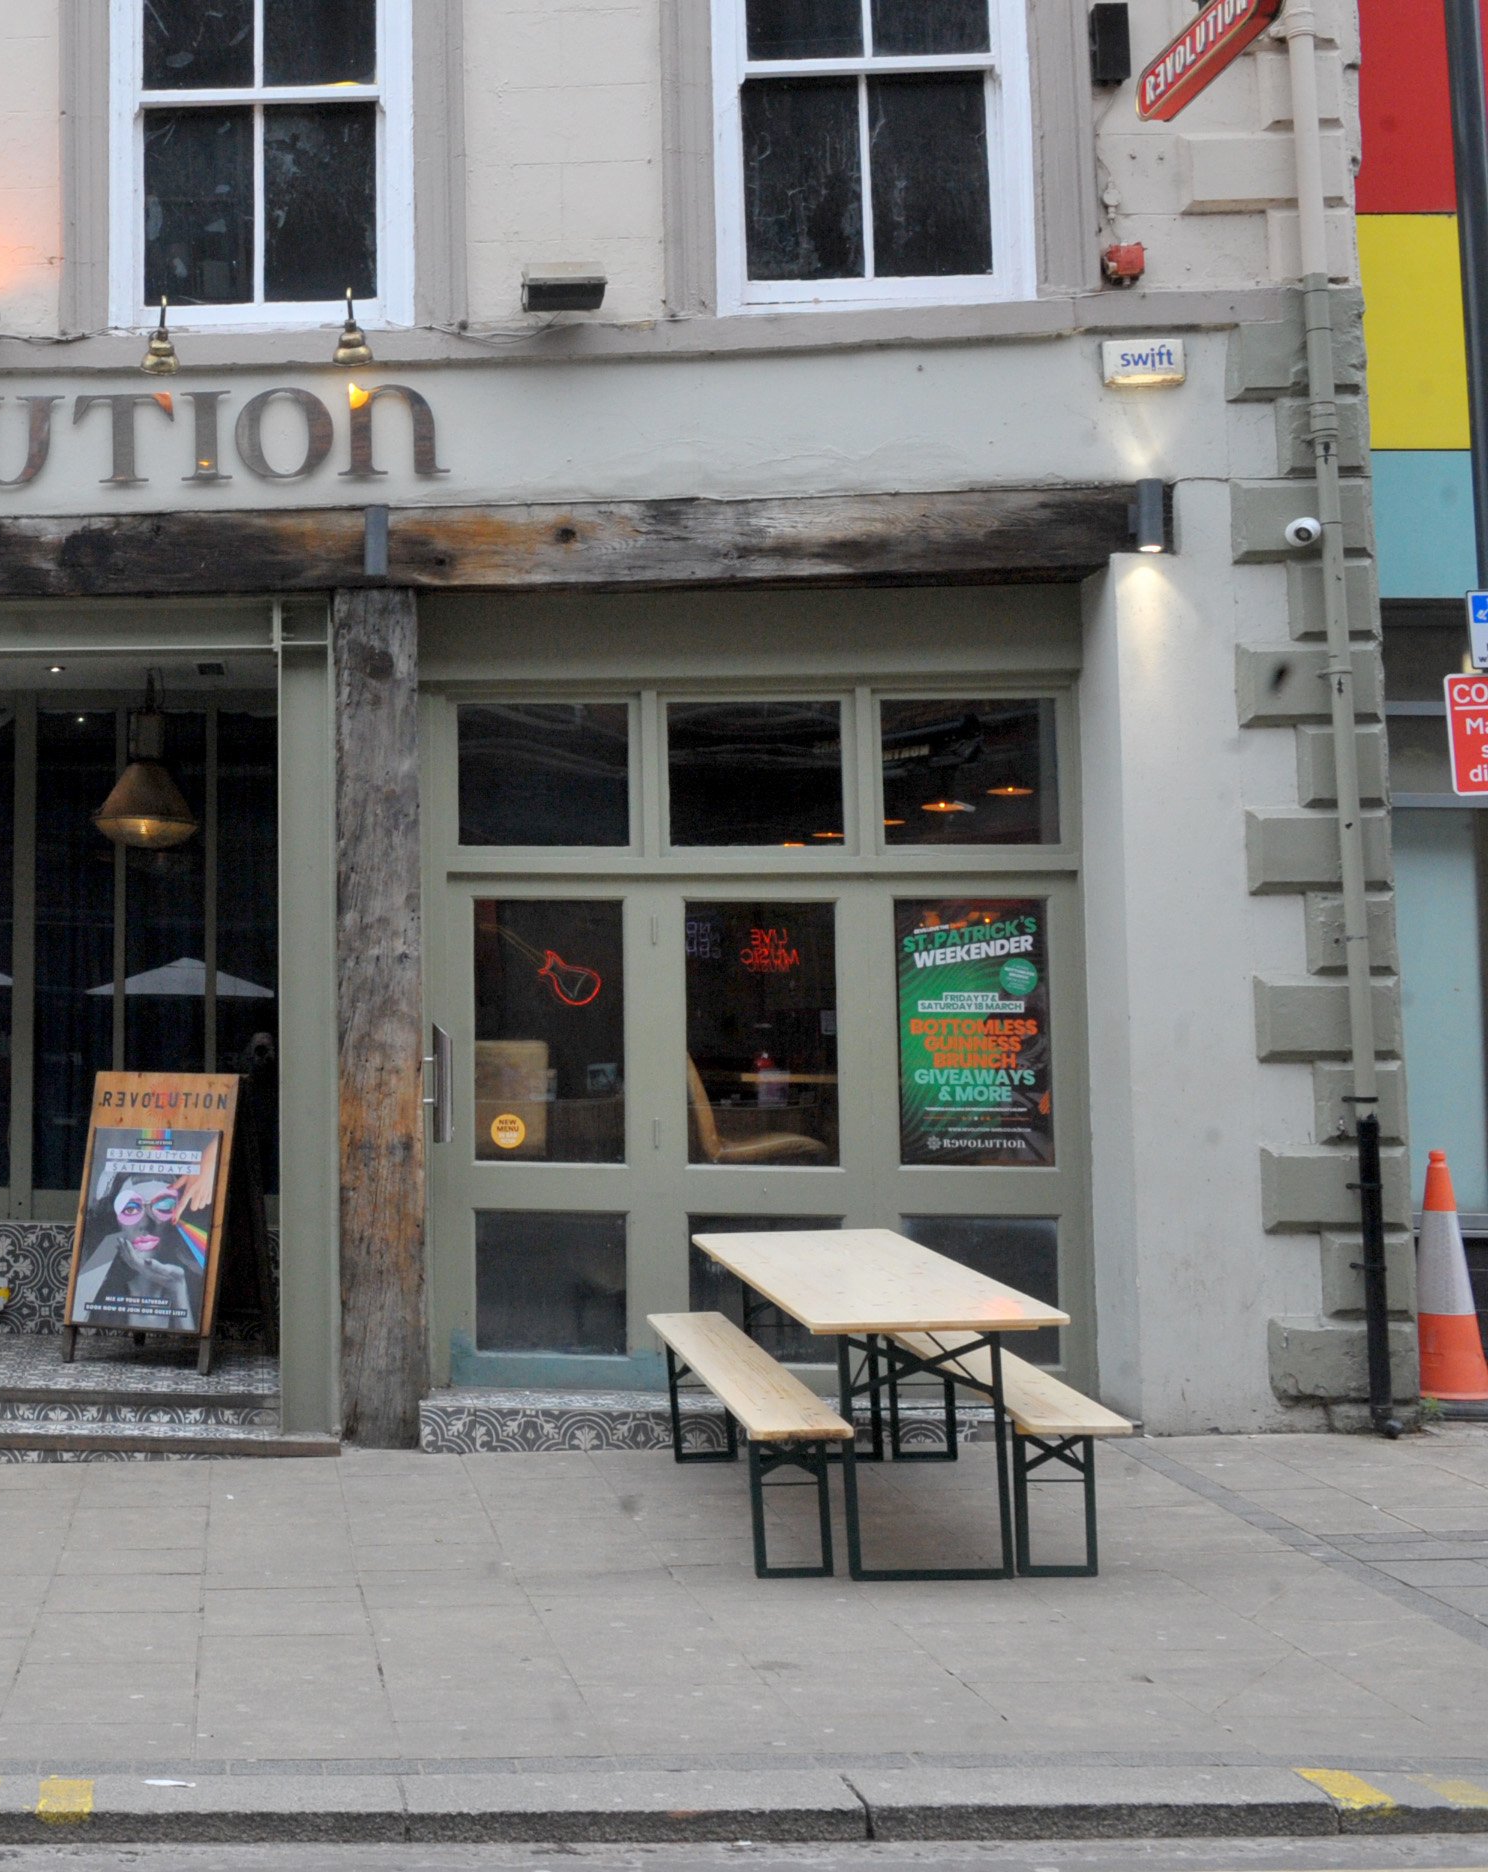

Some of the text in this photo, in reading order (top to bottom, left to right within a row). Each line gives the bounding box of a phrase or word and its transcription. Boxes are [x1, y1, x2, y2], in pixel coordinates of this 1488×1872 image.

[1120, 344, 1174, 372] swift
[1465, 717, 1488, 736] M
[914, 935, 1034, 969] WEEKENDER
[944, 994, 980, 1002] FRIDAY
[920, 1002, 1023, 1011] SATURDAY 18 MARCH
[910, 1018, 1039, 1036] BOTTOMLESS
[924, 1036, 1022, 1053] GUINNESS
[934, 1053, 1018, 1069] BRUNCH
[914, 1069, 1036, 1085] GIVEAWAYS
[102, 1091, 228, 1110] REVOLUTION
[938, 1085, 1013, 1101] & MORE
[112, 1163, 193, 1173] SATURDAYS
